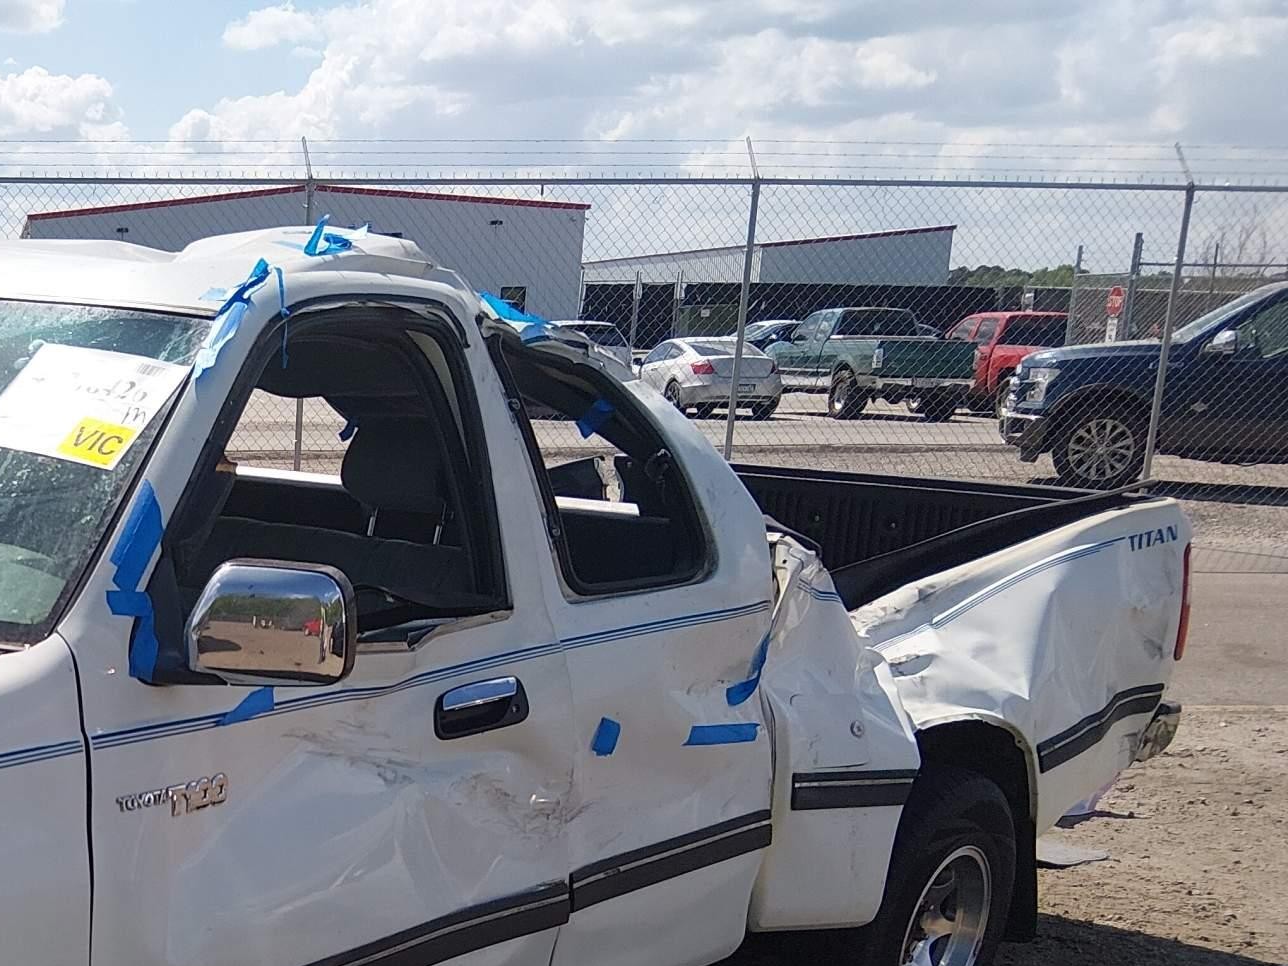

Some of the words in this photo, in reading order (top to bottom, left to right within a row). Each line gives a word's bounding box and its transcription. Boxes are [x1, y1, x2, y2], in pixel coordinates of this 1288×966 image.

[1107, 295, 1124, 307] STOP
[73, 425, 124, 456] VIC
[1128, 524, 1179, 552] TITAN
[116, 789, 168, 812] TOYOTA
